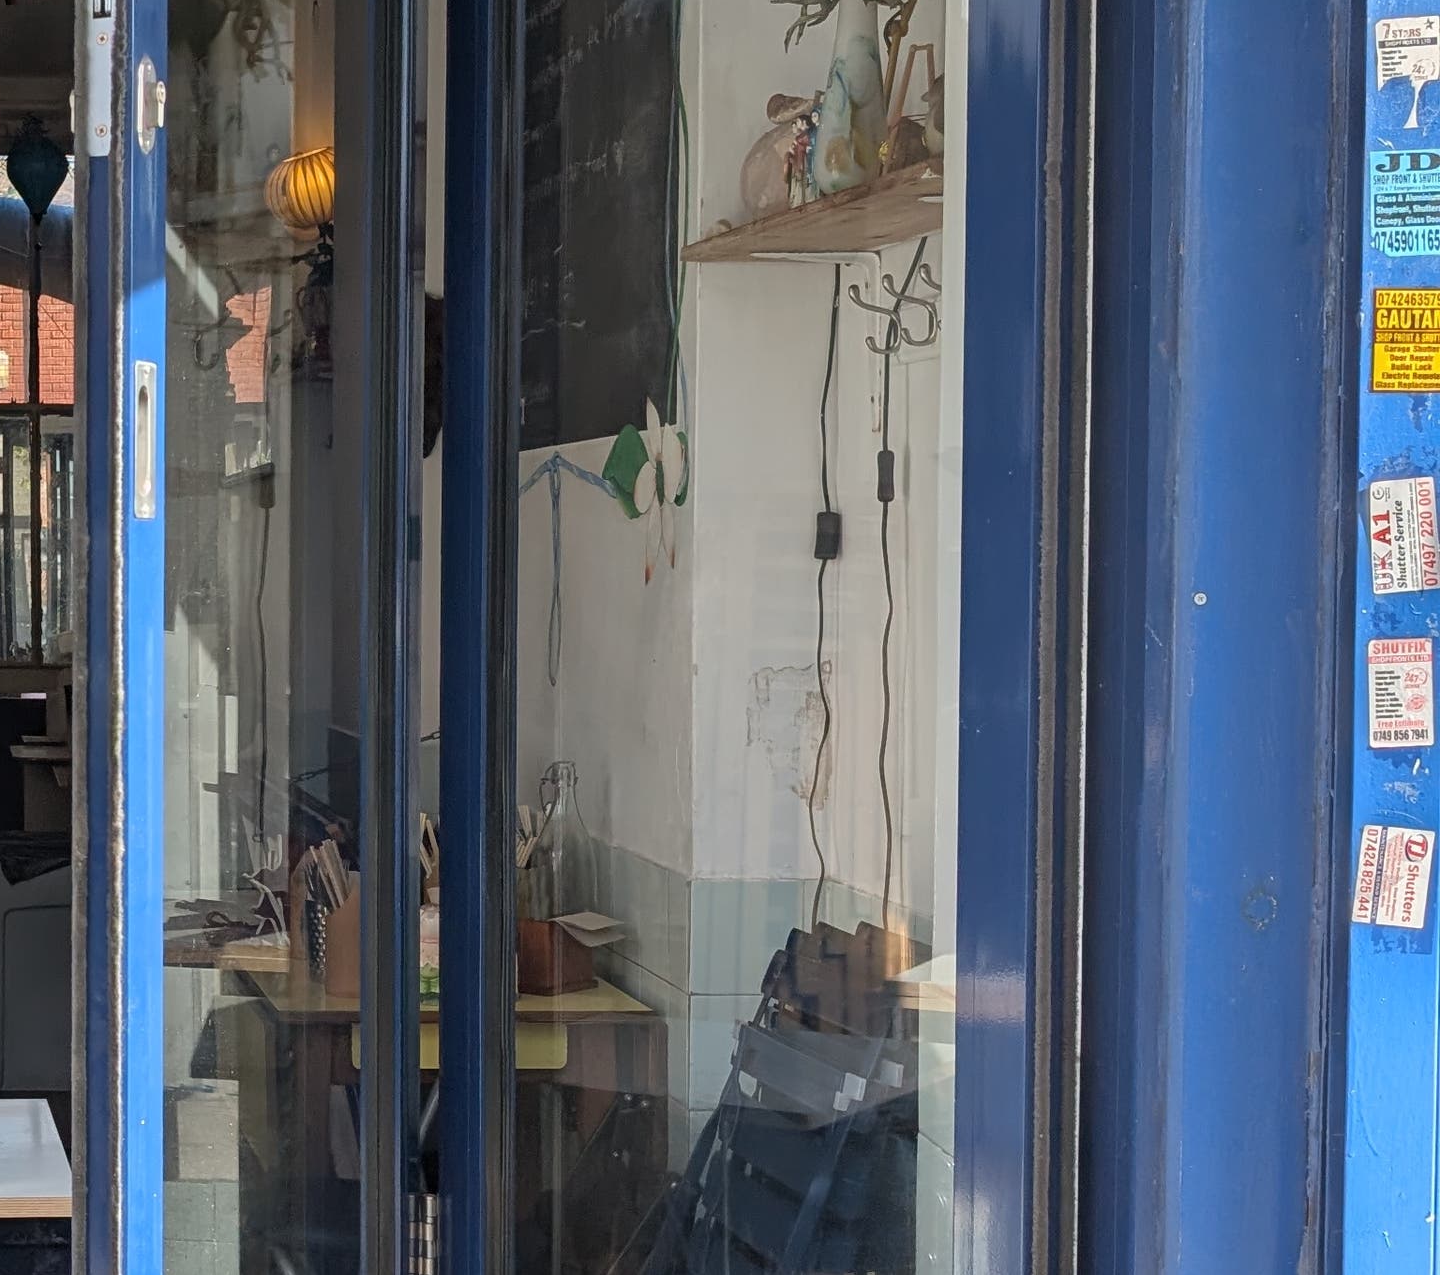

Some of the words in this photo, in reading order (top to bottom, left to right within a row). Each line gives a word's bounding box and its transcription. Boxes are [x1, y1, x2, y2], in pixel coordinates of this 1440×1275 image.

[1383, 23, 1390, 39] 7
[1375, 152, 1440, 172] JD
[1373, 175, 1389, 185] SHOP
[1391, 174, 1411, 184] FRONT
[1413, 173, 1417, 183] &
[1376, 195, 1396, 203] Glass
[1405, 216, 1425, 224] Glass
[1376, 333, 1392, 342] SHOP
[1393, 333, 1414, 342] FRONT
[1384, 345, 1410, 353] Garage
[1409, 354, 1434, 362] Repair
[1417, 481, 1431, 506] 001
[1372, 510, 1392, 546] A1
[1392, 500, 1405, 542] Service
[1420, 511, 1434, 537] 220
[1373, 549, 1394, 591] UK
[1396, 543, 1408, 589] Shutter
[1422, 543, 1438, 586] 07497
[1373, 642, 1427, 655] SHUTFIX
[1416, 654, 1429, 662] LTD
[1373, 730, 1392, 741] 0749
[1394, 729, 1409, 741] 856
[1411, 729, 1429, 740] 7941
[1363, 829, 1378, 867] 07424
[1407, 839, 1426, 858] TJ
[1360, 870, 1373, 893] 825
[1402, 865, 1419, 923] Shutters
[1357, 896, 1370, 918] 441
